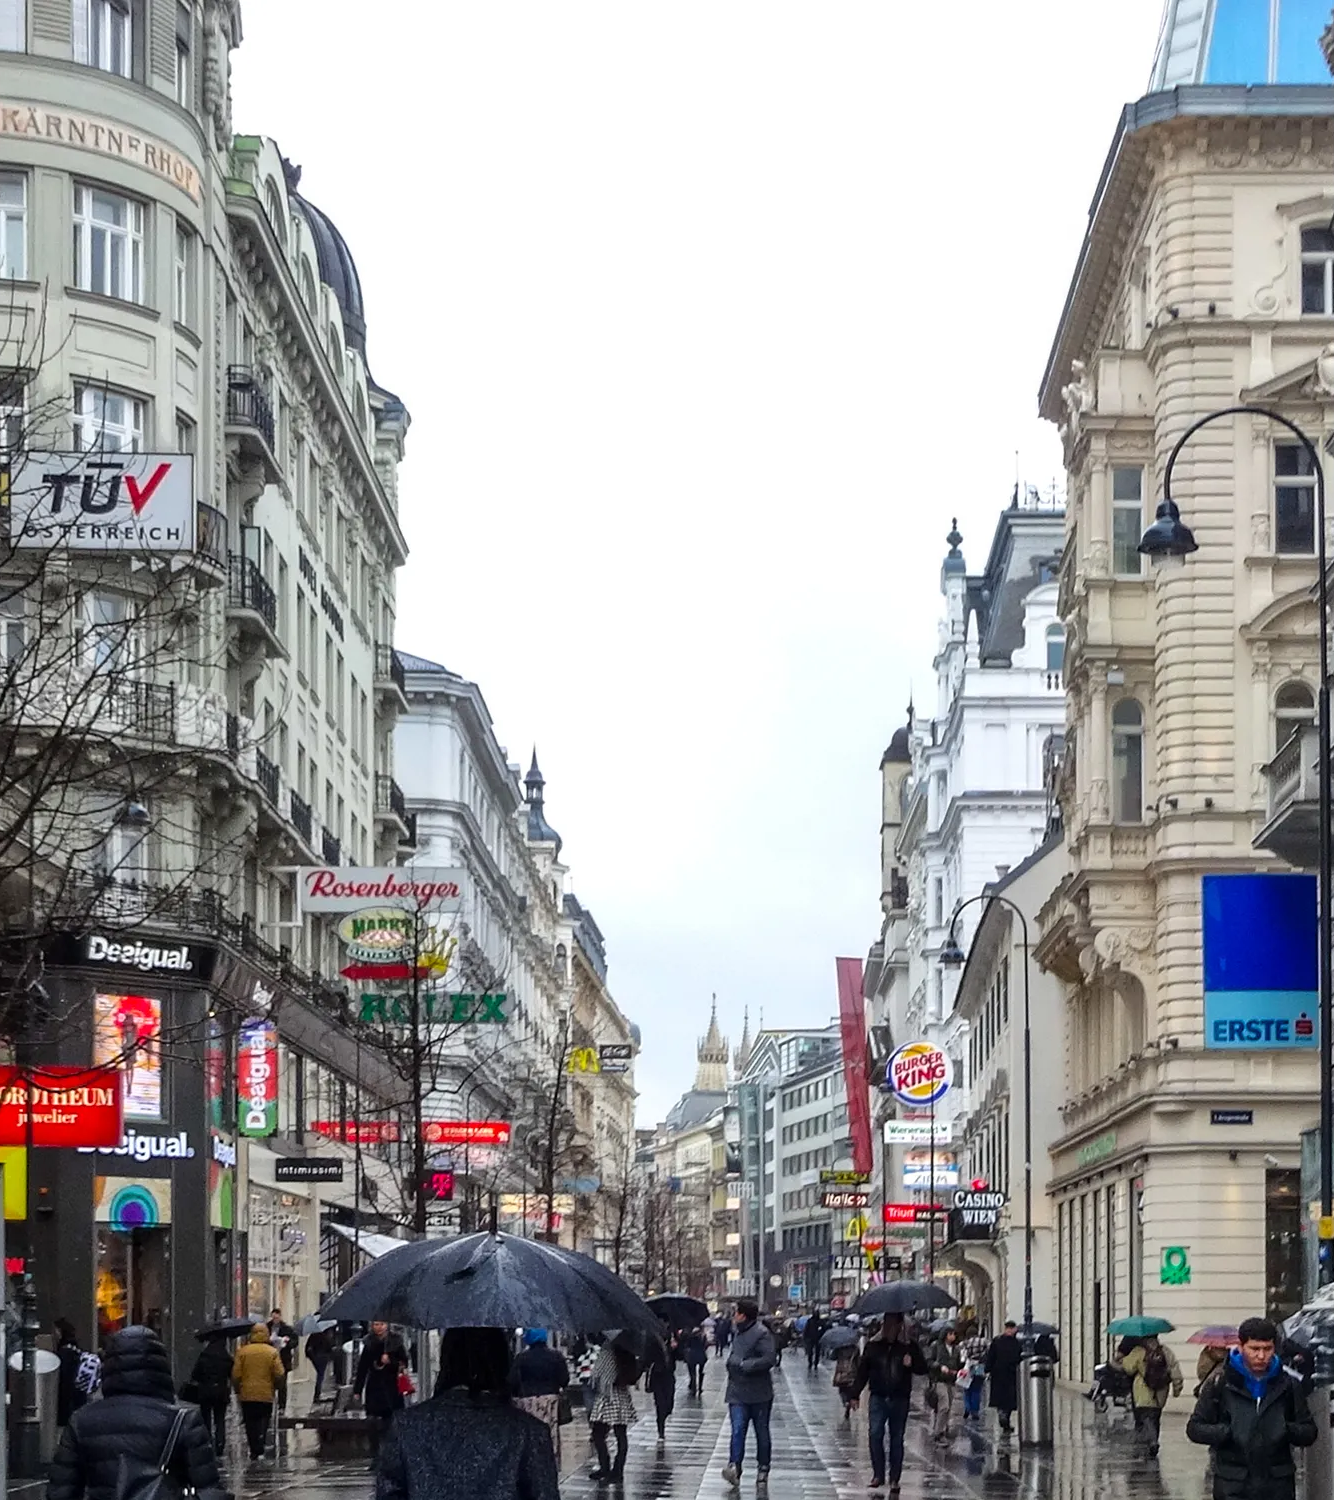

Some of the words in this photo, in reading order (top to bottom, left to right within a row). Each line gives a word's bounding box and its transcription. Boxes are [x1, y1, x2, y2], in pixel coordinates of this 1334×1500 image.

[41, 462, 173, 516] TÜV
[305, 869, 460, 908] Rosenberger
[1213, 1018, 1290, 1042] ERSTE
[894, 1050, 944, 1074] BURGER
[896, 1063, 947, 1092] KING
[888, 1125, 939, 1135] Wienerwad
[277, 1165, 343, 1176] intimissimi
[953, 1189, 1005, 1208] CASINO
[961, 1209, 997, 1225] WIEN
